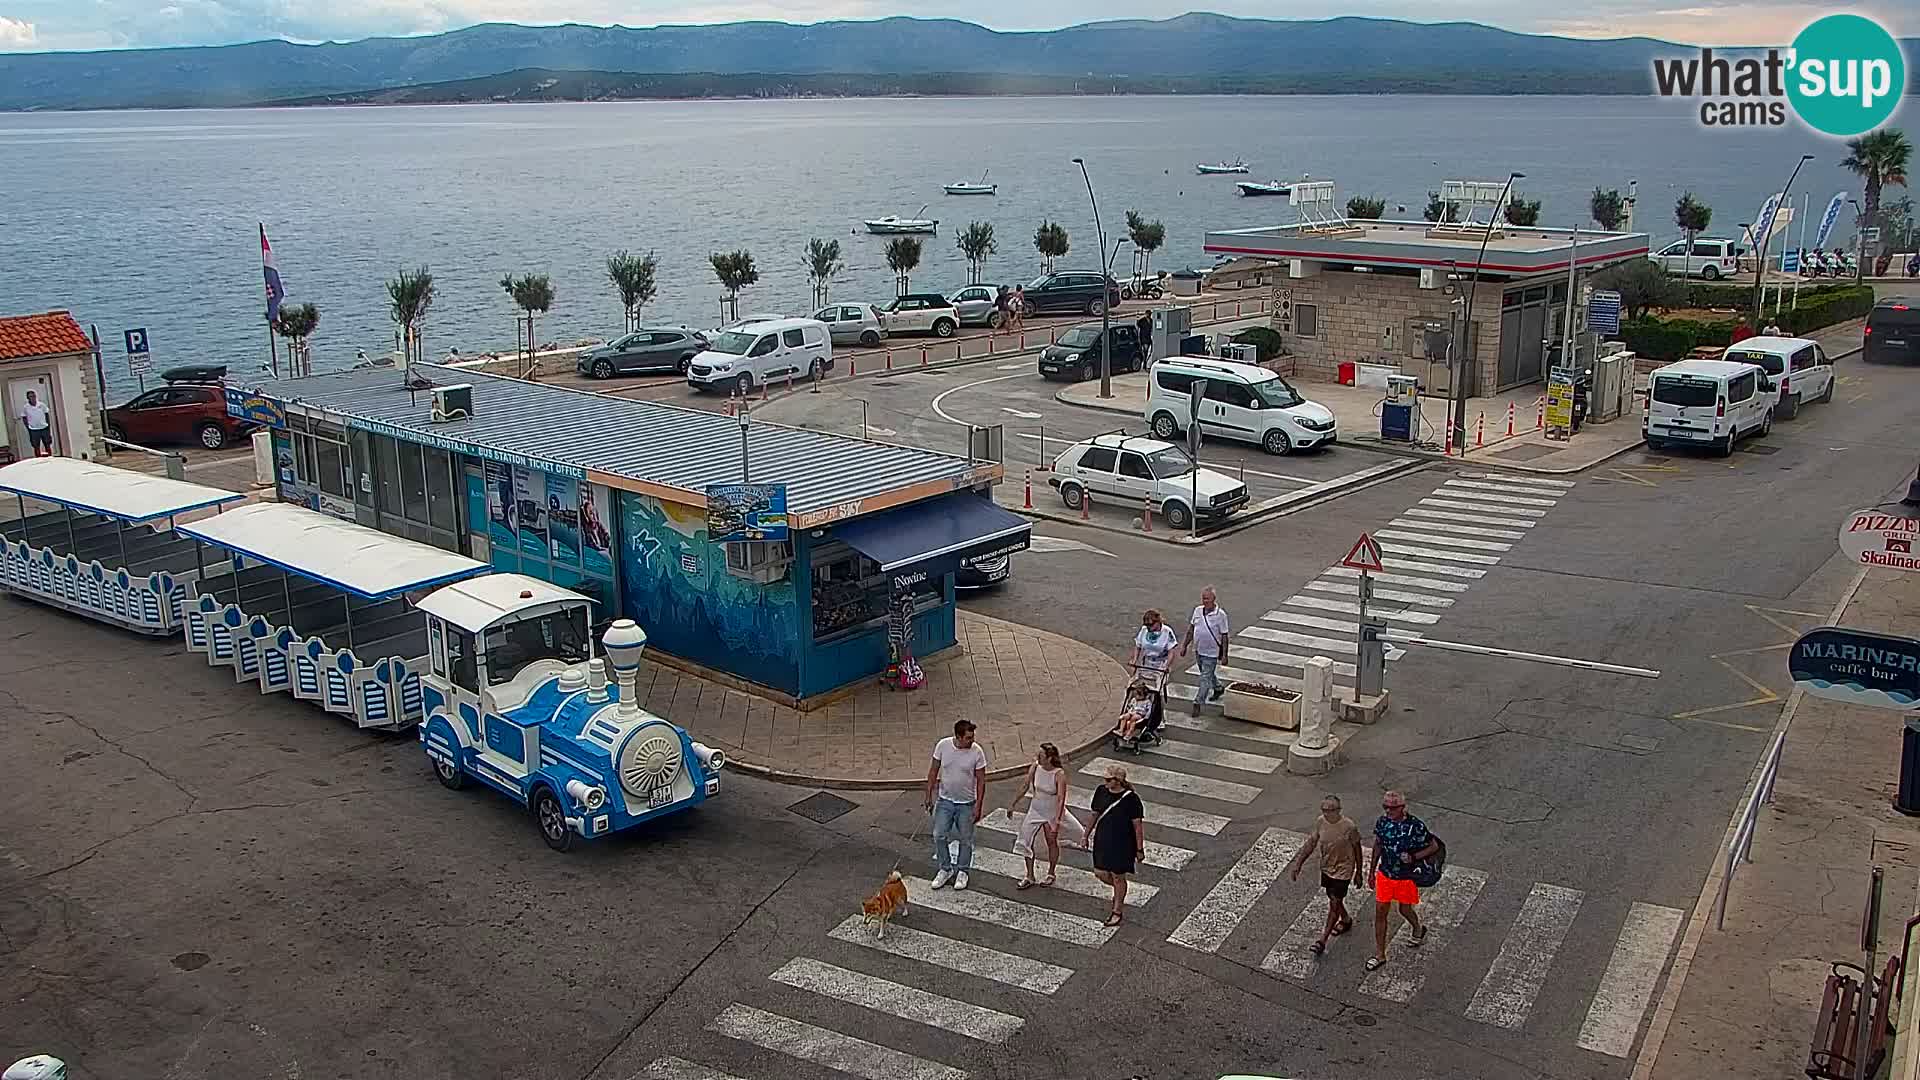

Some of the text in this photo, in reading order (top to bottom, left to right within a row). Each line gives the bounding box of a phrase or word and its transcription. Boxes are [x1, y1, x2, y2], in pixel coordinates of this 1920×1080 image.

[130, 332, 143, 350] P
[1746, 352, 1764, 360] TAXI
[436, 439, 468, 453] POSTAJA
[478, 446, 493, 459] BUS
[495, 449, 526, 466] STATION
[529, 457, 555, 472] TICKET
[555, 463, 582, 478] OFFICE
[1848, 515, 1920, 534] PIZZE
[1882, 531, 1917, 541] GRILL
[1801, 642, 1920, 673] MARINER
[1830, 663, 1898, 681] caffe bar
